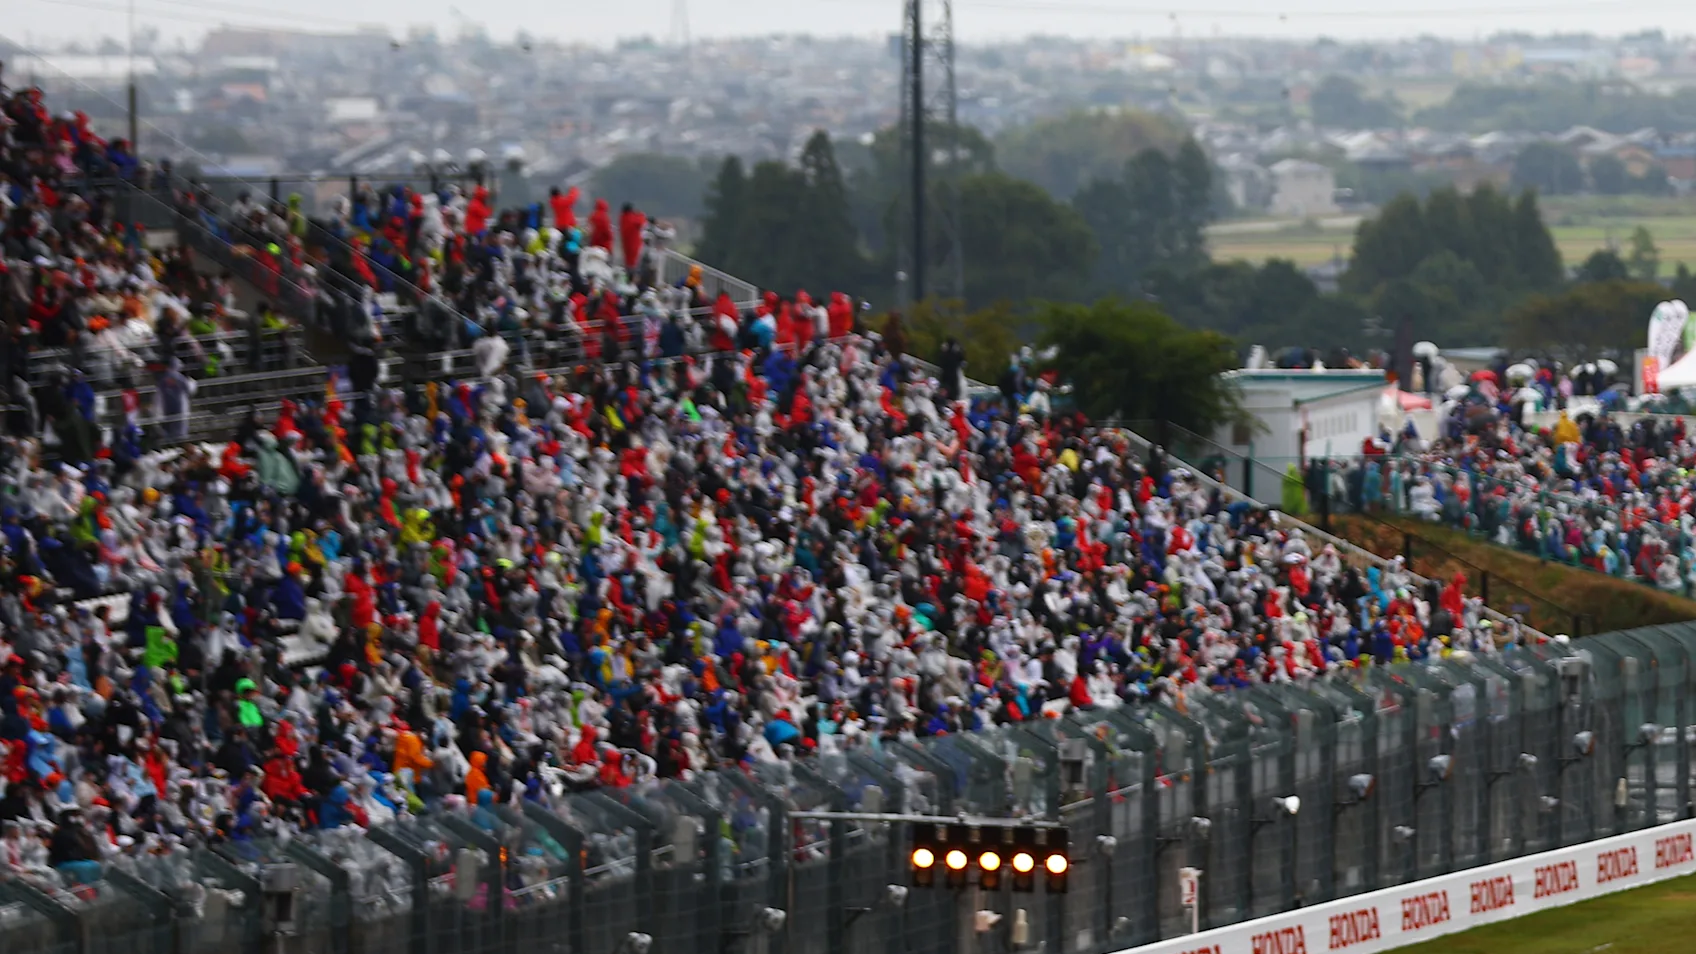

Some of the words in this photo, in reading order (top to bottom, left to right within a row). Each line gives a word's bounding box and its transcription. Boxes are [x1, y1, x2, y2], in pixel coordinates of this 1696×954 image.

[1597, 847, 1638, 884] HONDA
[1656, 834, 1694, 868] HONDA
[1471, 875, 1515, 914] HONDA
[1535, 861, 1579, 899] HONDA
[1328, 908, 1381, 949] HONDA
[1401, 890, 1450, 932] HONDA
